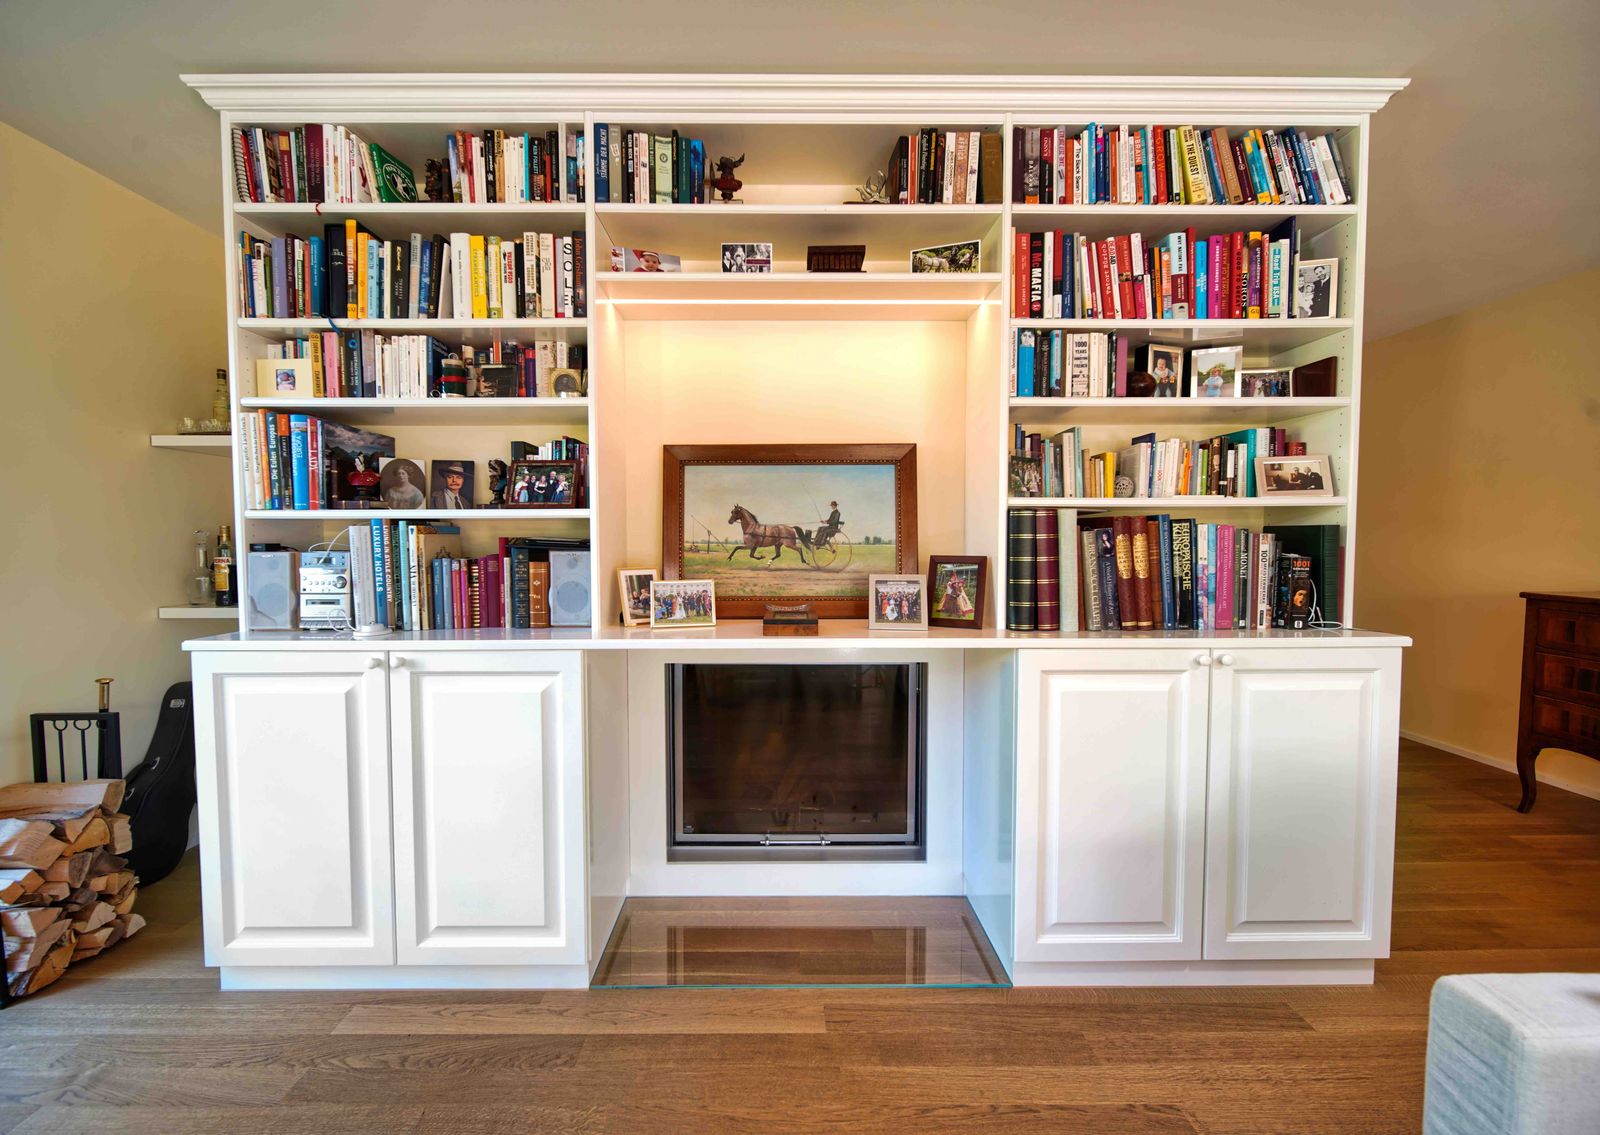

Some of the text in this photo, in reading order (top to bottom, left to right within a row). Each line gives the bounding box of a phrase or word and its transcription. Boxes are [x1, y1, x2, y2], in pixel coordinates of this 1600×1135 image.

[969, 134, 979, 166] EMPIRE
[1155, 138, 1165, 171] GROW
[1186, 143, 1200, 177] THE QUEST
[575, 238, 584, 287] John Grisham
[1108, 240, 1116, 255] DEAD
[1273, 254, 1281, 271] Road
[1031, 252, 1042, 302] McMAFIA
[1103, 270, 1112, 294] Tatort
[1234, 251, 1242, 308] GOOD TO GREAT
[1253, 247, 1261, 289] Schwangerschaft
[1272, 272, 1280, 285] Trip
[1241, 272, 1249, 307] SOROS
[268, 424, 277, 449] Europas
[309, 449, 318, 472] LADY
[1172, 523, 1183, 556] KUNST
[373, 525, 384, 592] LUXURY HOTELS
[1182, 522, 1192, 591] EUROPÄISCHE
[1239, 552, 1248, 579] MONET
[1260, 550, 1268, 564] 100
[1105, 566, 1113, 581] World
[1091, 595, 1101, 628] CHAPEL
